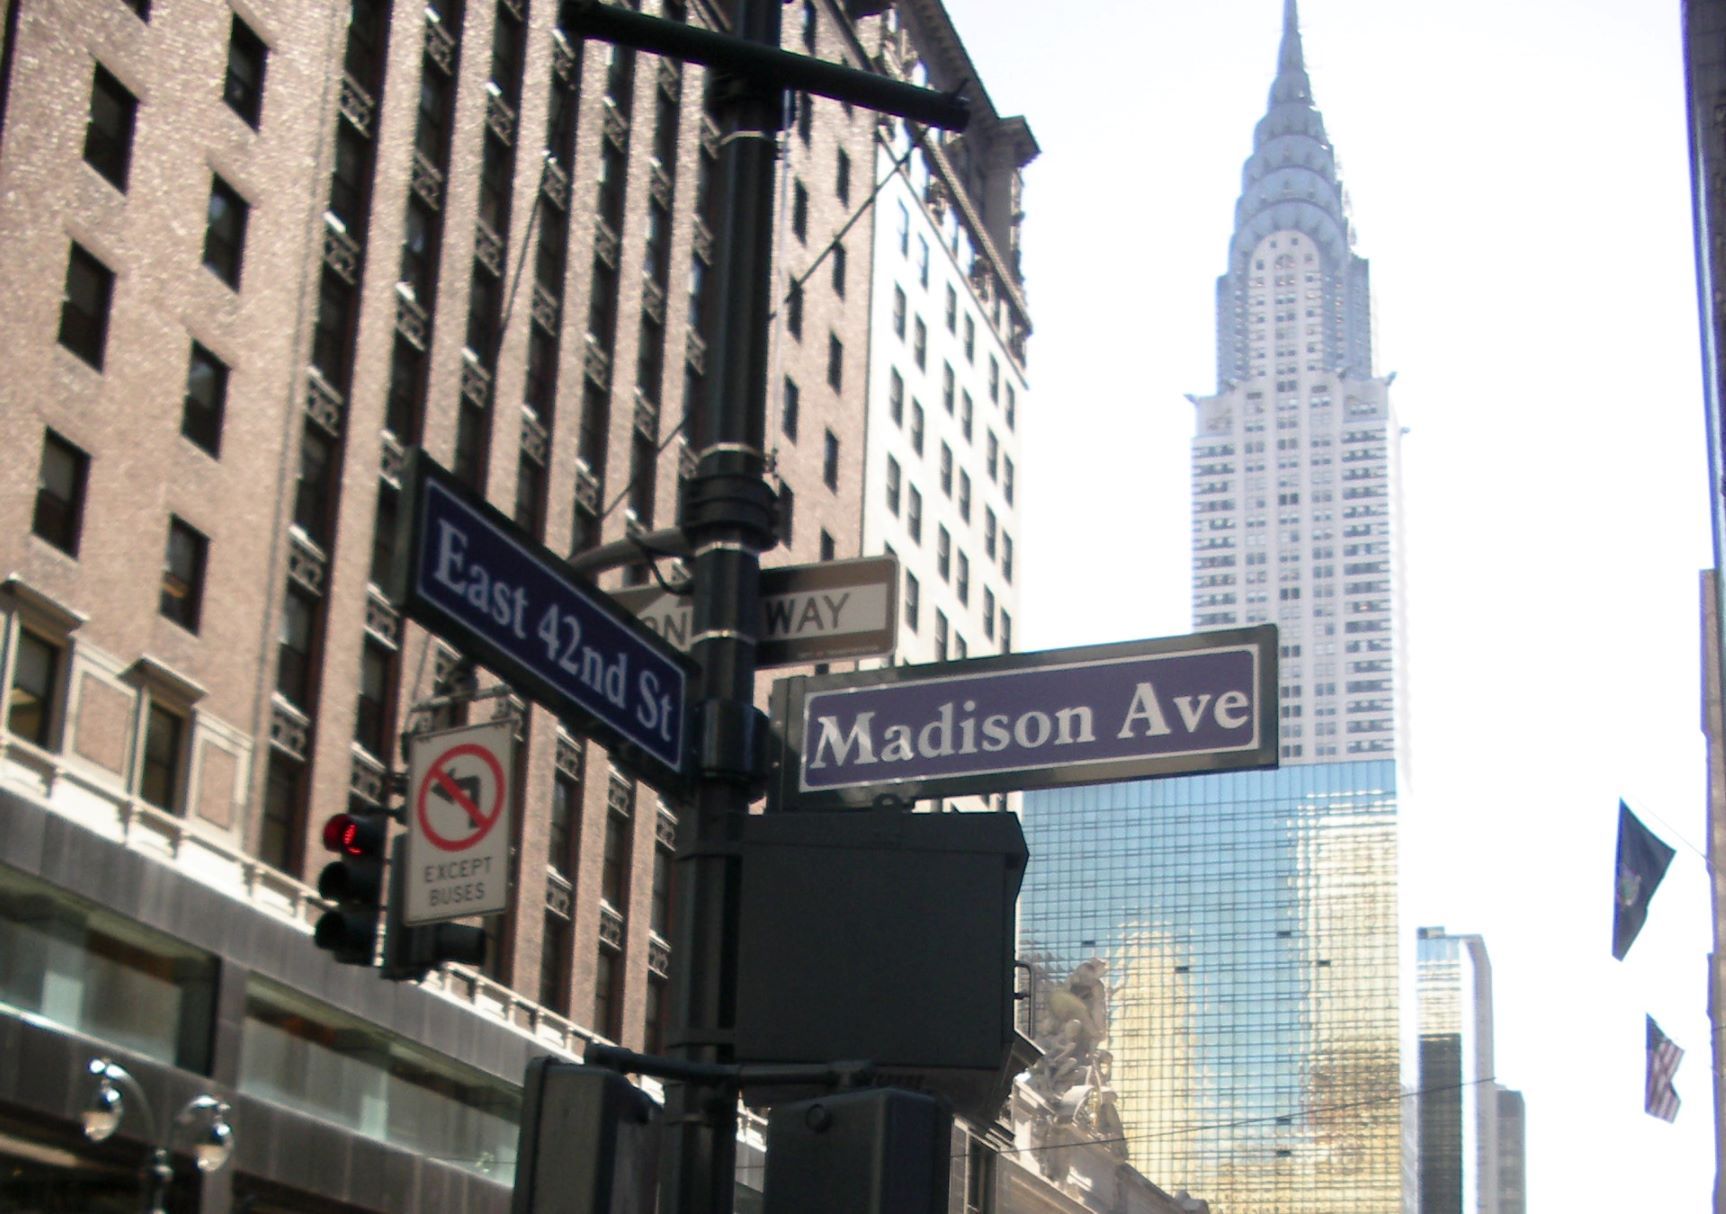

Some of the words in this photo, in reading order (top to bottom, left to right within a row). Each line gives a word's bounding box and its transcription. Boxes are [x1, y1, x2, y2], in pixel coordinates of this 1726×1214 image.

[433, 518, 528, 639] East
[537, 603, 628, 709] 42nd
[636, 670, 672, 742] St
[764, 593, 849, 636] WAY
[809, 700, 1096, 769] Madison
[1117, 682, 1251, 740] Ave
[424, 856, 493, 884] EXCEPT
[429, 882, 486, 907] BUSES
